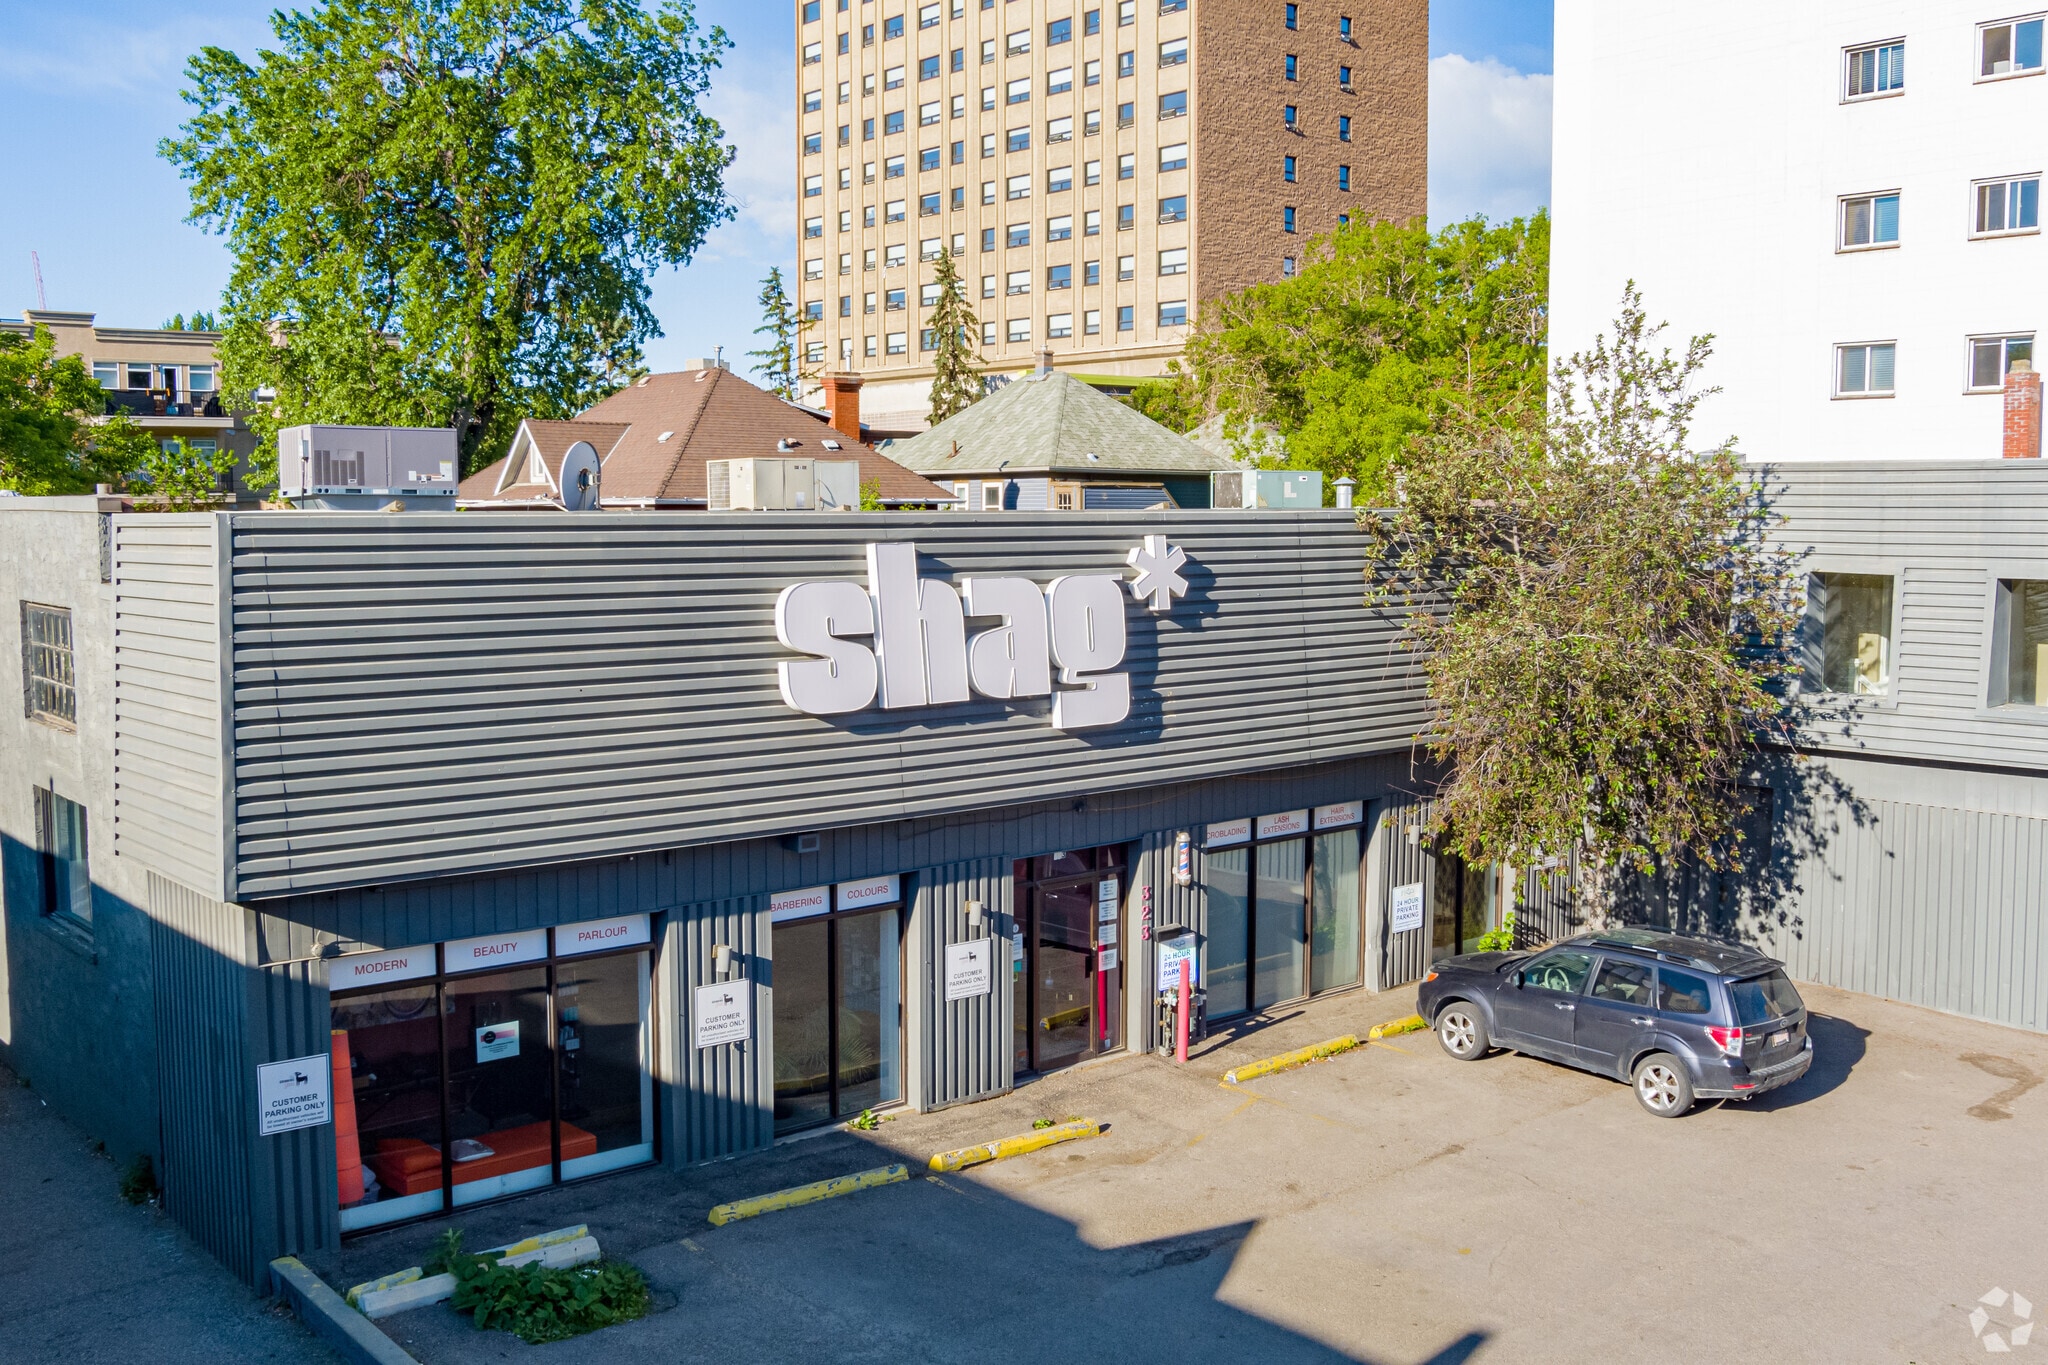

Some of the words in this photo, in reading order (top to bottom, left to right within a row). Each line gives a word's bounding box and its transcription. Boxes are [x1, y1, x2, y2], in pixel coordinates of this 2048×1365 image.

[1331, 806, 1344, 814] HAIR
[1274, 815, 1290, 825] LASH
[1319, 813, 1355, 825] EXTENSIONS
[1263, 822, 1300, 834] EXTENSIONS
[847, 884, 889, 900] COLOURS
[770, 896, 823, 912] BARBERING
[1404, 897, 1419, 905] HOUR
[1141, 885, 1151, 941] 323
[1397, 904, 1419, 914] PRIVATE
[1396, 911, 1419, 921] PARKING
[578, 925, 628, 942] PARLOUR
[473, 942, 518, 958] BEAUTY
[354, 958, 408, 976] MODERN
[953, 969, 983, 979] CUSTOMER
[949, 978, 972, 987] PARKING
[705, 1012, 741, 1024] CUSTOMER
[700, 1022, 728, 1033] PARKING
[729, 1019, 746, 1028] ONLY
[272, 1093, 318, 1108] CUSTOMER
[265, 1105, 301, 1118] PARKING
[303, 1101, 326, 1111] ONLY
